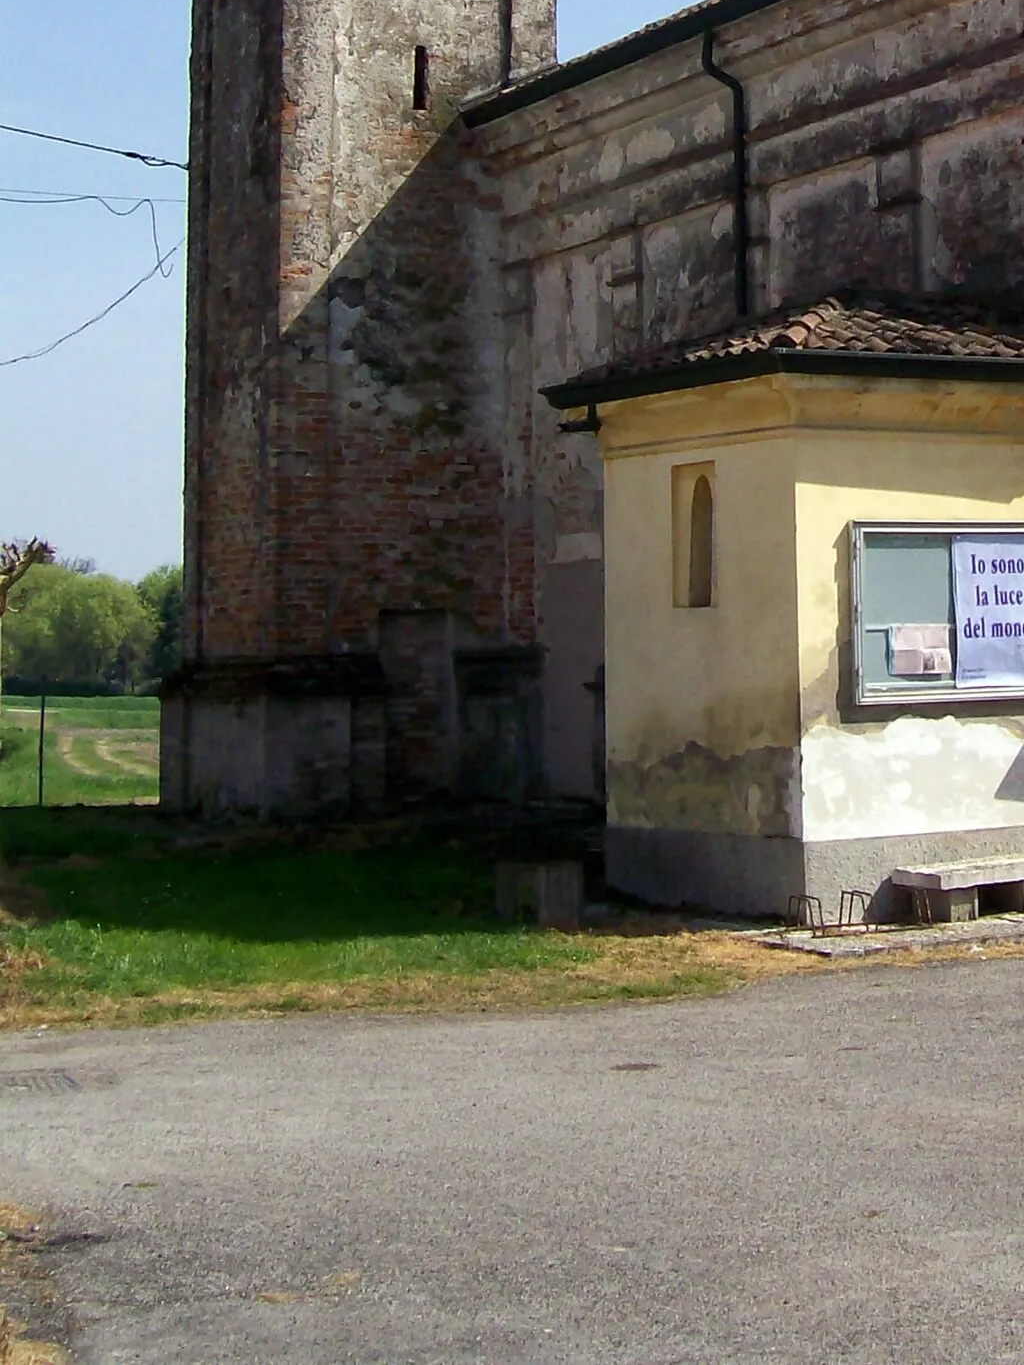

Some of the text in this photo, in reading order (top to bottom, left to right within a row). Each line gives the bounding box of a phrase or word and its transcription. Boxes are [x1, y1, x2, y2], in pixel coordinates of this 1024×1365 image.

[970, 553, 1024, 575] Io sono
[975, 584, 1024, 607] la luce
[963, 617, 986, 639] del
